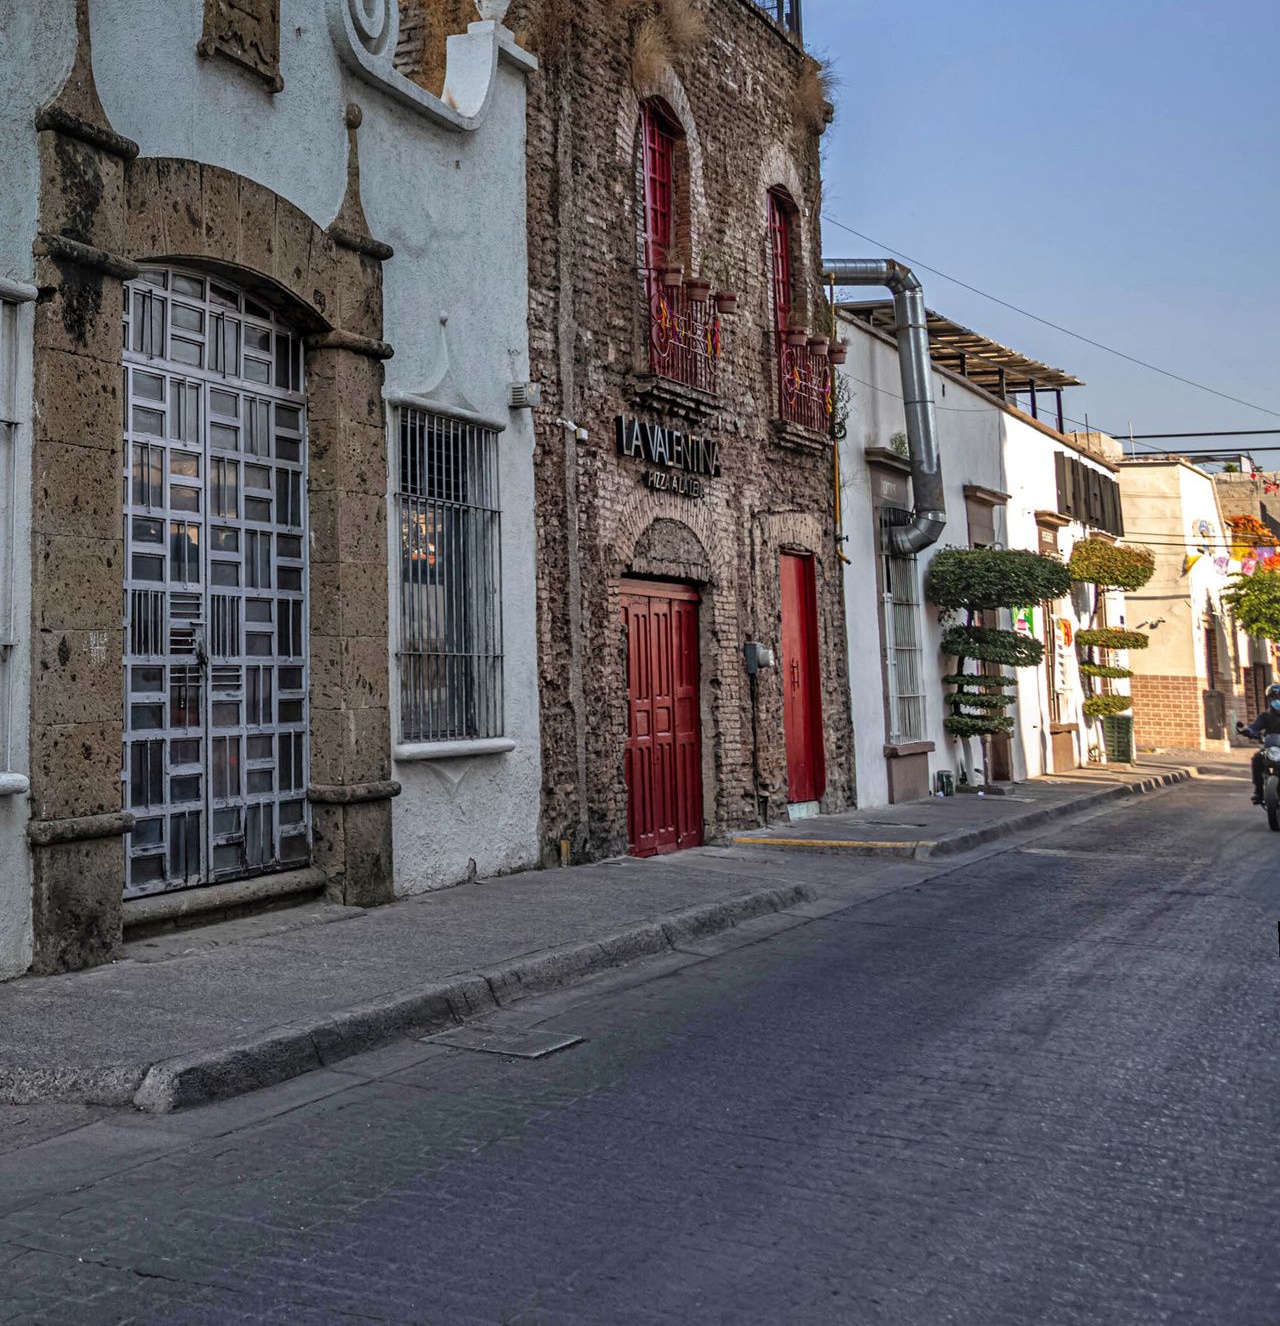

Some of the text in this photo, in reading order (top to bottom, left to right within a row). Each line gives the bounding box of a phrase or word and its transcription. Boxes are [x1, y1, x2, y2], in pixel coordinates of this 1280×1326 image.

[620, 414, 721, 476] LA VALENTINA
[648, 471, 670, 490] PIZZA
